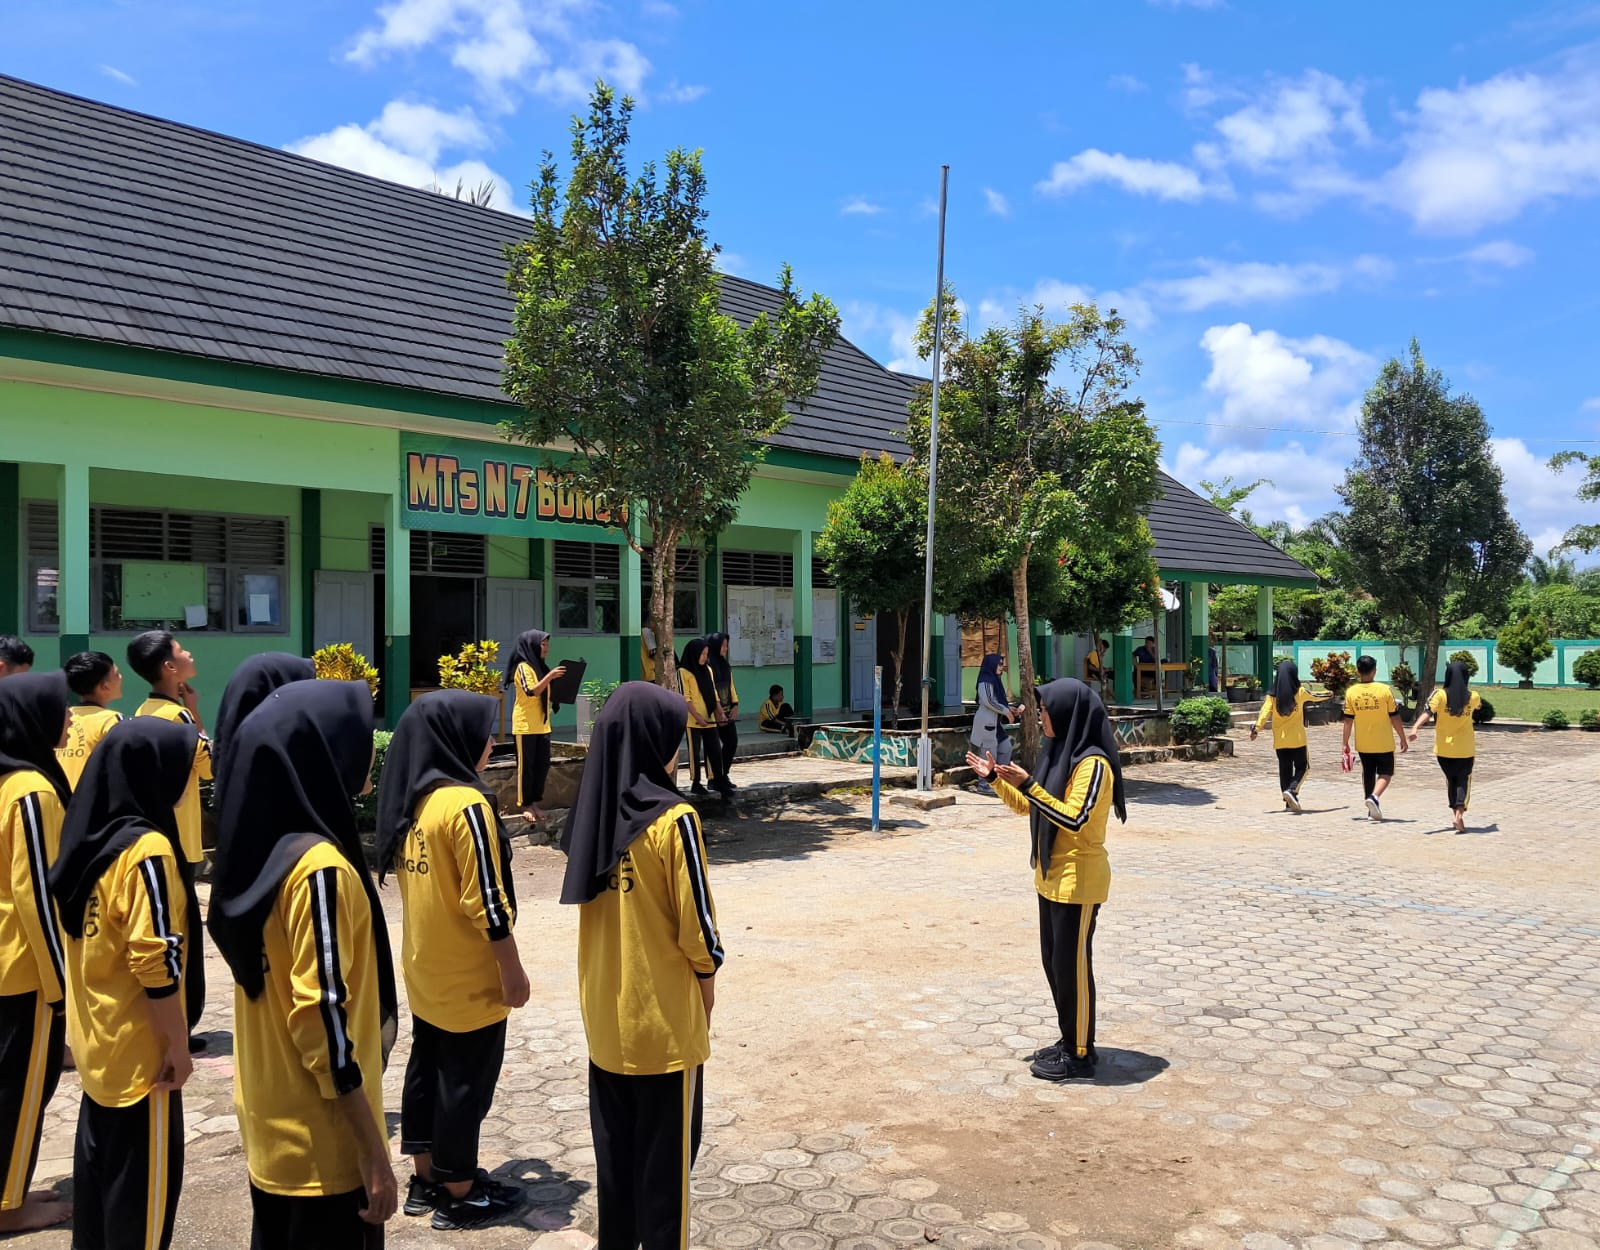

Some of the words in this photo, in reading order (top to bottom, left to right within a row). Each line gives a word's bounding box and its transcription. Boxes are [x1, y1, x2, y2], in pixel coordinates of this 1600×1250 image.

[408, 452, 479, 516] MTs
[483, 460, 508, 518] N
[510, 463, 534, 520] 7
